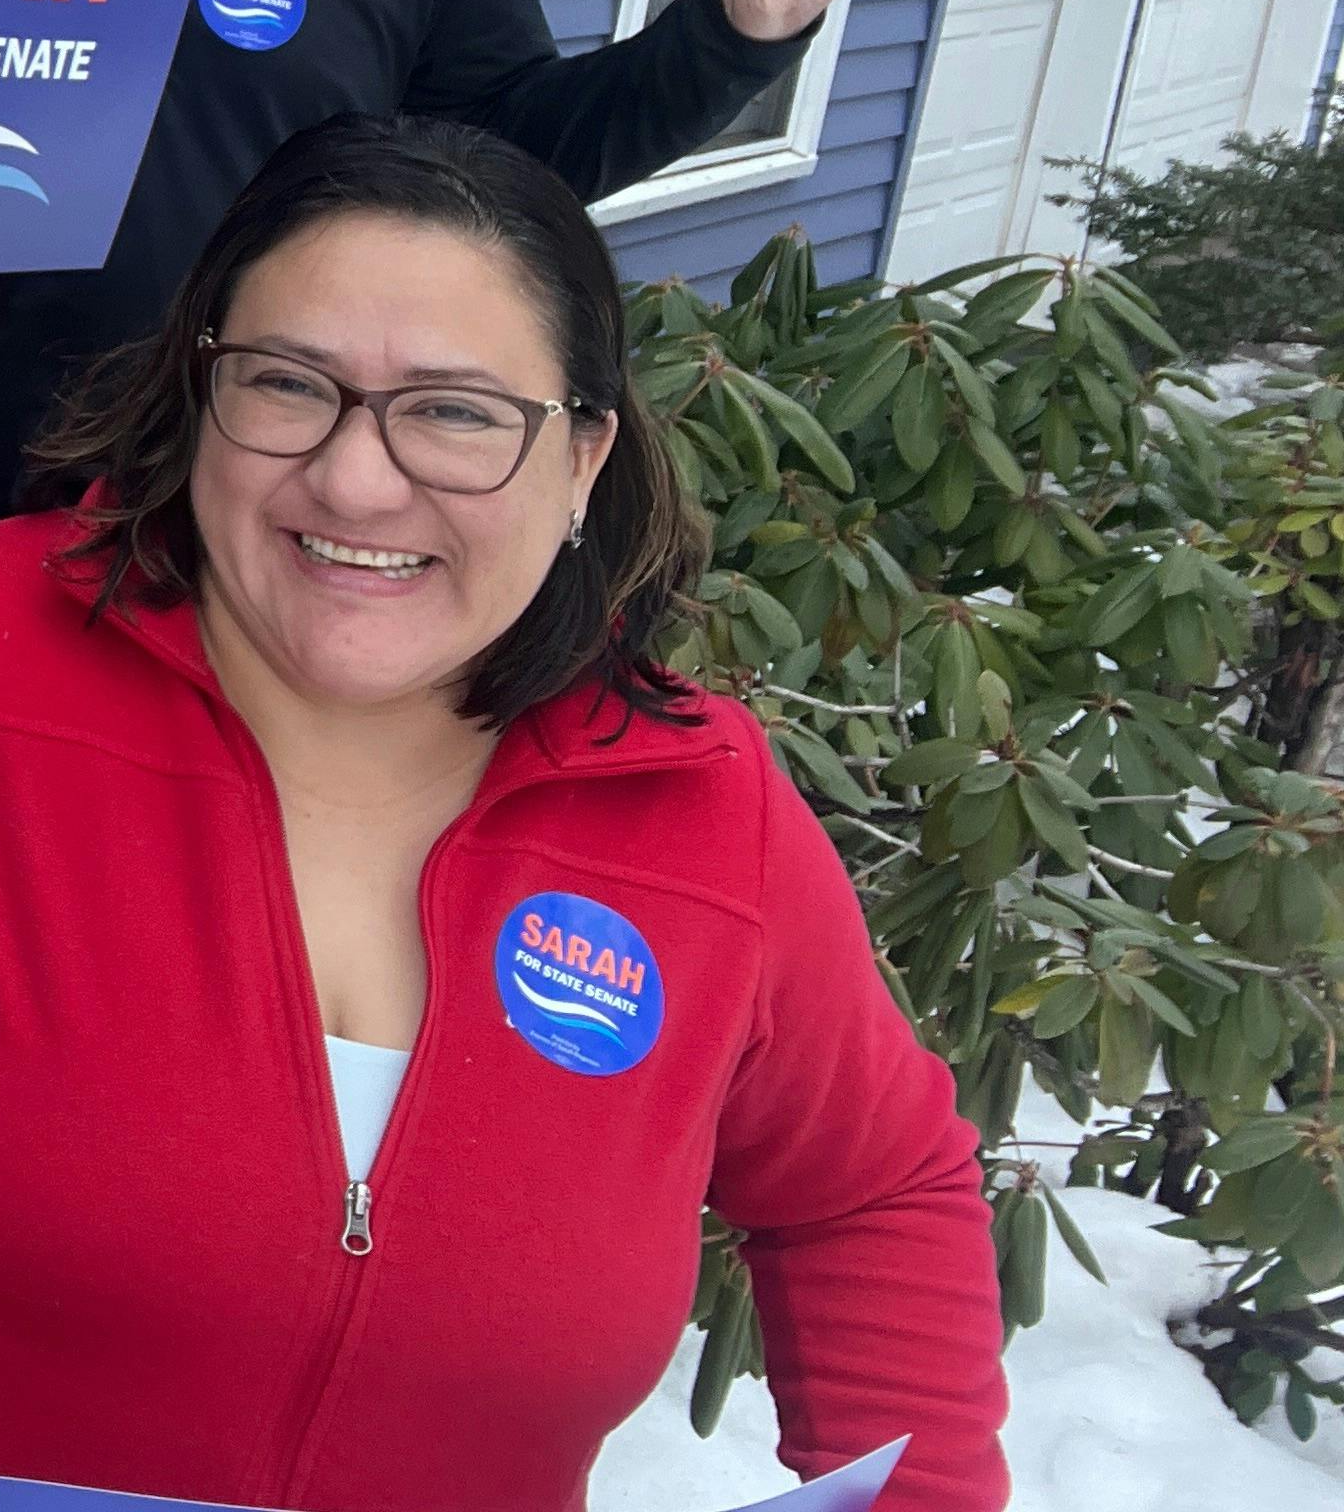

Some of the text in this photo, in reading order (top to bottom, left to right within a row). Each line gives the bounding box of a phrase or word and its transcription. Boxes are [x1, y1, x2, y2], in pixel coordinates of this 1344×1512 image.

[515, 949, 639, 1017] FOR STATE SENATE
[520, 913, 645, 995] SARAH
